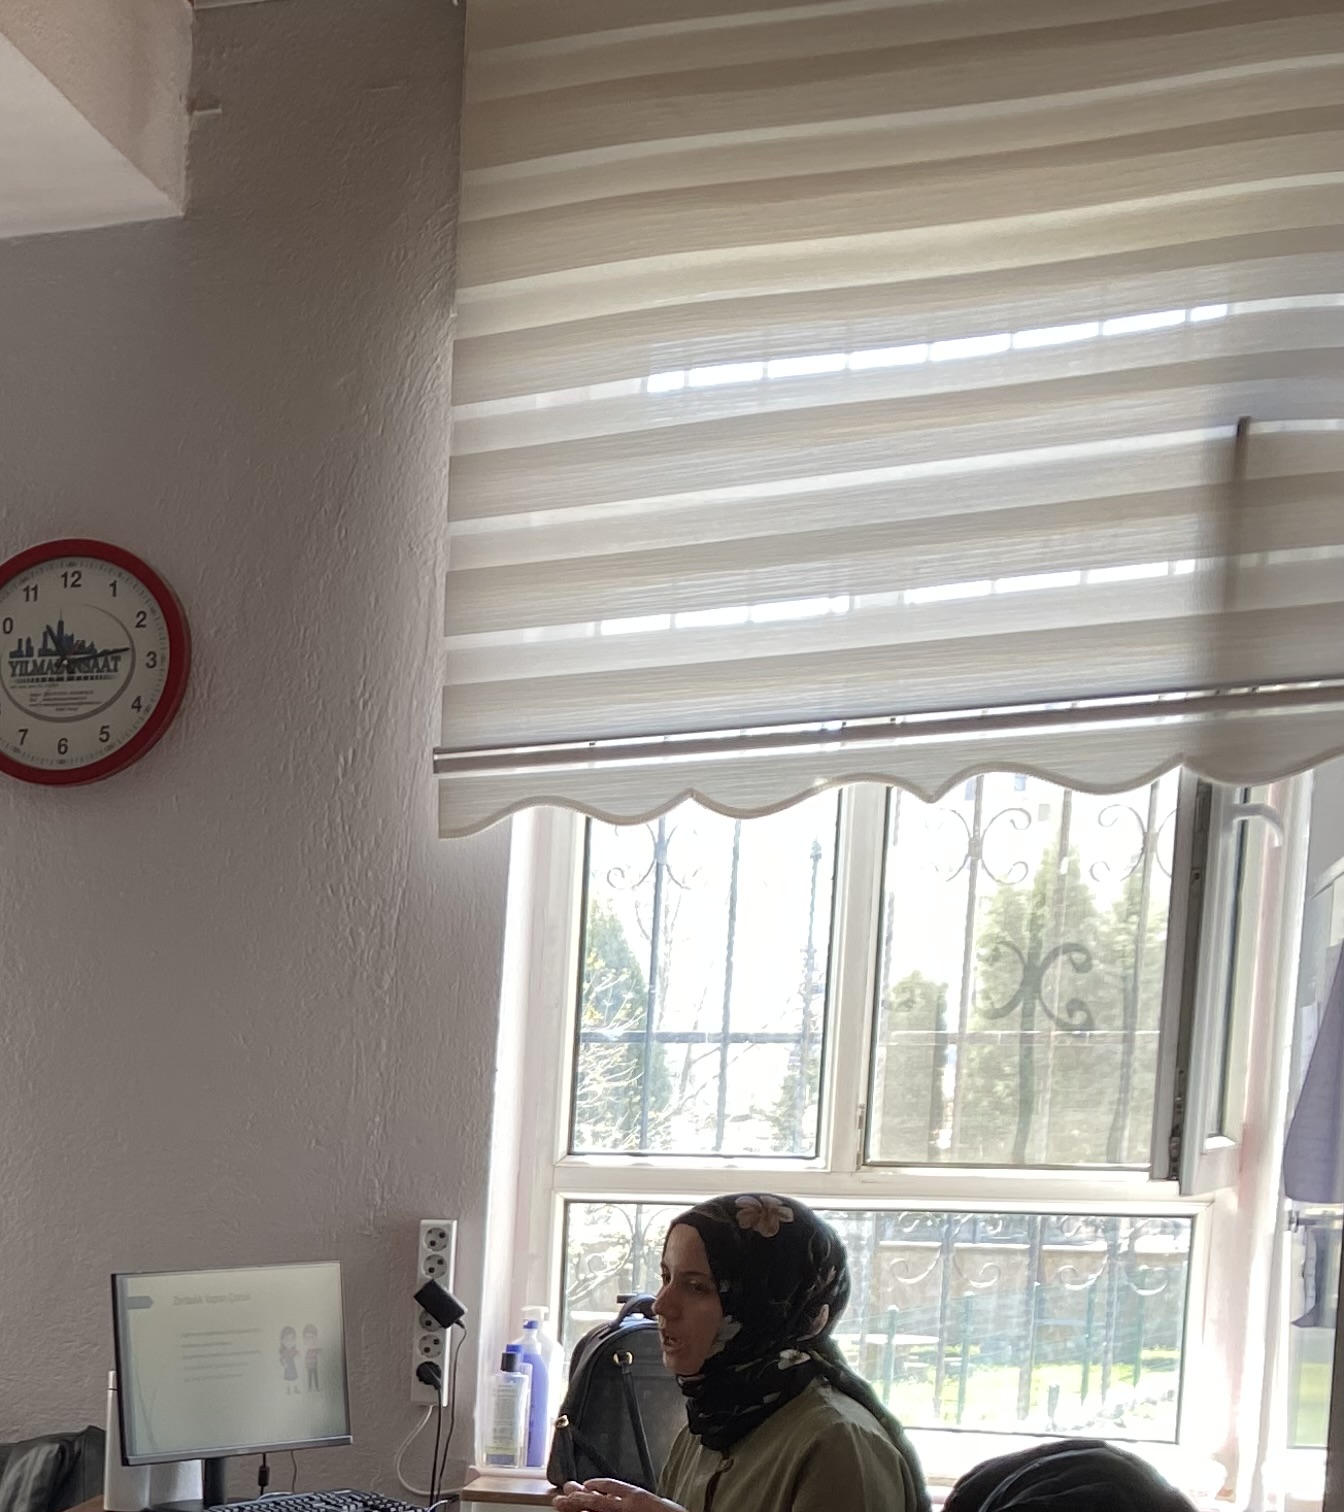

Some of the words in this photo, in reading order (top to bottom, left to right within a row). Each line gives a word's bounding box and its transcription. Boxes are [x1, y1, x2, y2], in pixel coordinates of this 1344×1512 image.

[61, 570, 82, 589] 12
[22, 584, 39, 602] 11
[109, 580, 117, 598] 1
[135, 611, 147, 628] 2
[145, 651, 157, 669] 3
[131, 696, 142, 713] 4
[18, 728, 29, 746] 7
[98, 725, 110, 743] 5
[57, 738, 68, 755] 6
